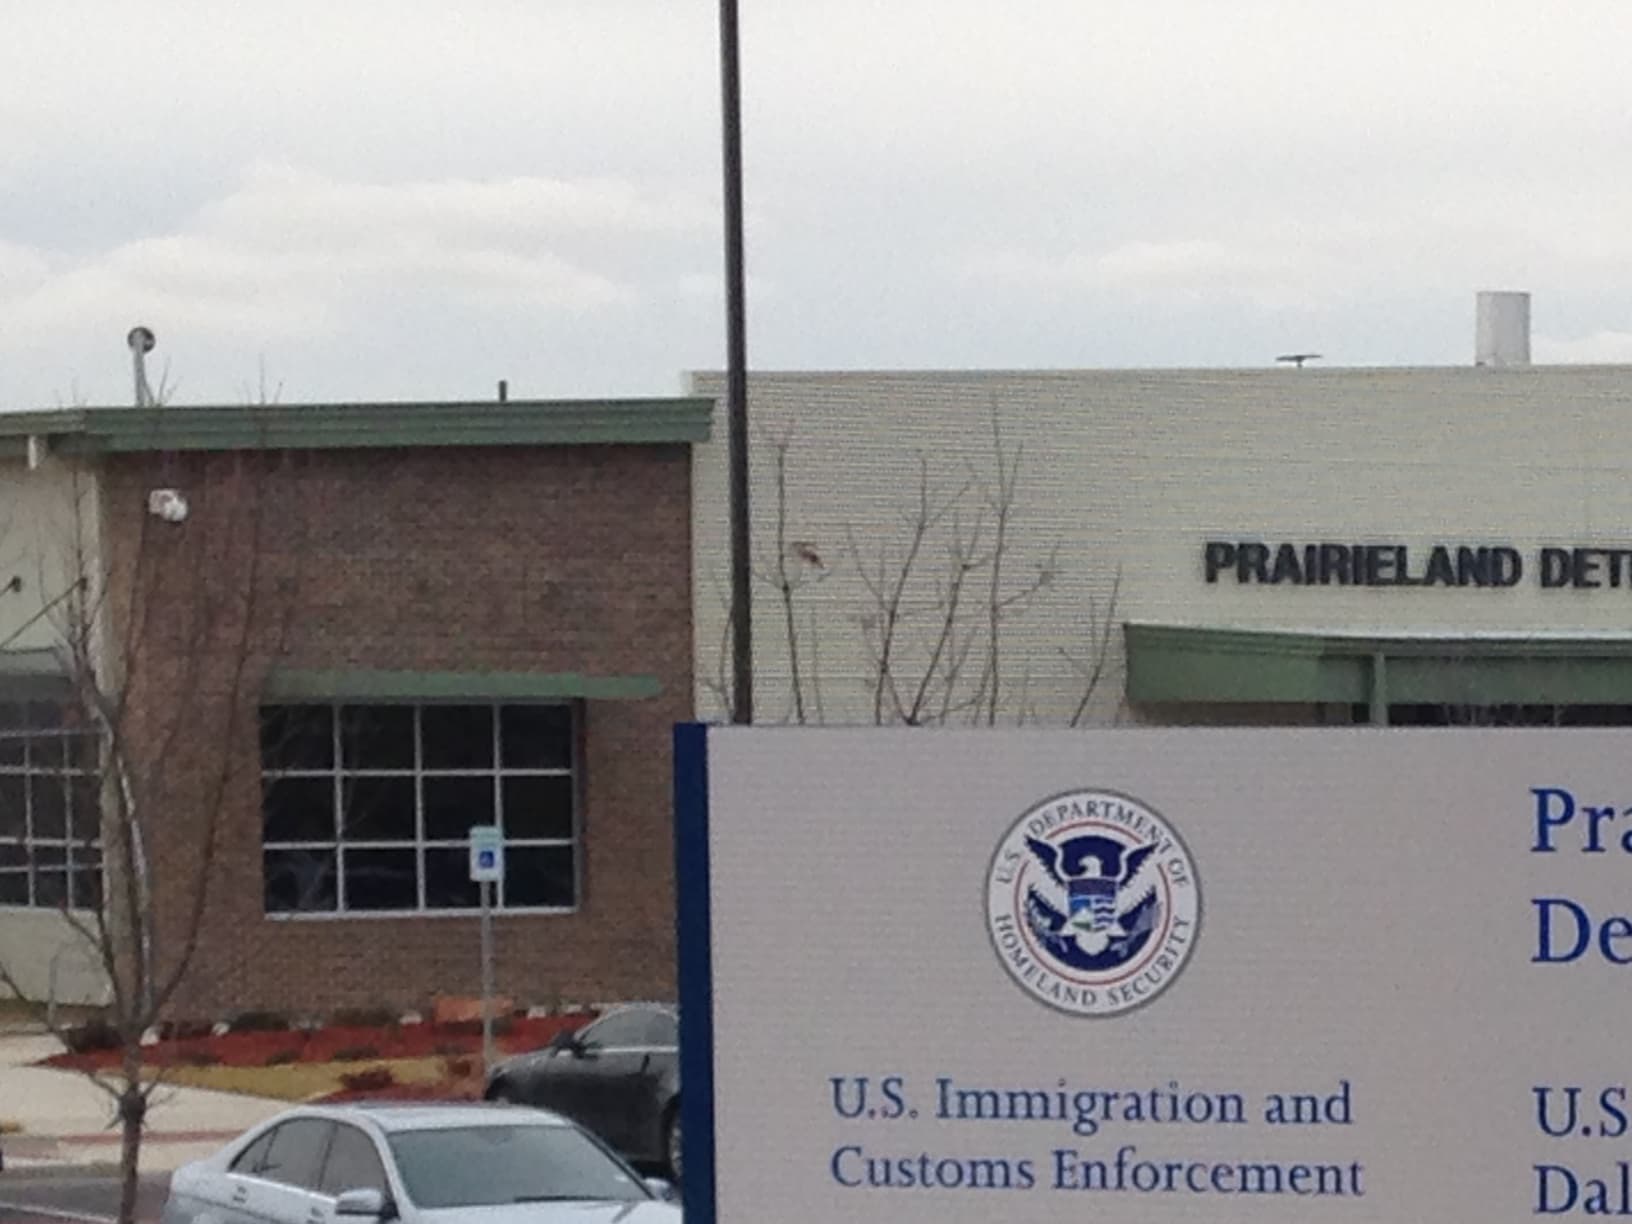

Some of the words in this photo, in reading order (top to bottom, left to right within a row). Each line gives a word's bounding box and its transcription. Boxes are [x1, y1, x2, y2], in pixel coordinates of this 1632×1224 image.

[1204, 541, 1523, 589] PRAIRIELAND
[1027, 799, 1173, 855] DEPARTMENT
[1166, 857, 1191, 888] OF
[994, 912, 1098, 1007] HOMELAND
[1107, 915, 1191, 1007] SECURITY
[829, 1077, 919, 1120] U.S.
[936, 1078, 1247, 1137] Immigration
[1265, 1080, 1354, 1125] and
[830, 1145, 1035, 1190] Customs
[1052, 1145, 1365, 1197] Enforcement
